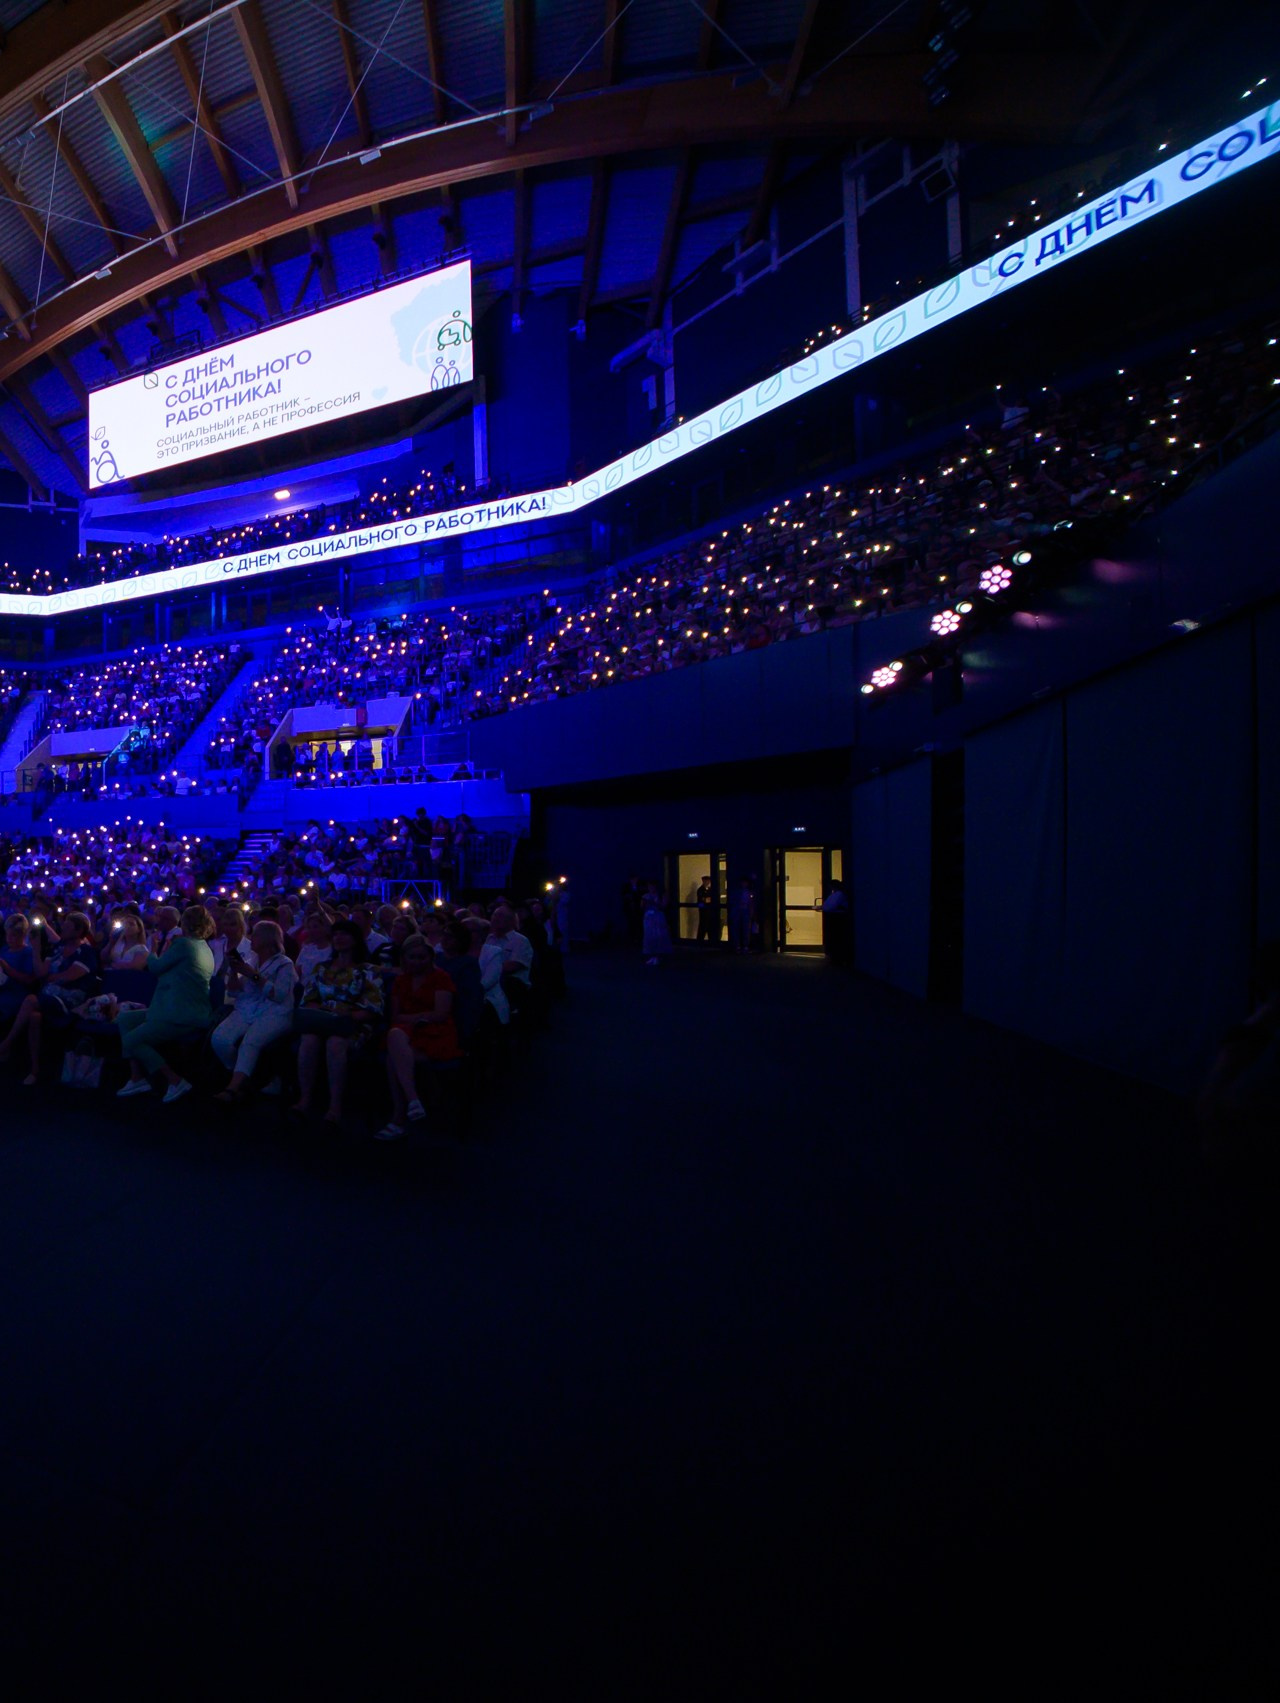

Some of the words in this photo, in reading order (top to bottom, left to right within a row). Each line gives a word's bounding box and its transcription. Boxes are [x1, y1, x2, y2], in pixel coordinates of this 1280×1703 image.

[998, 252, 1024, 278] С
[165, 374, 178, 389] С
[182, 353, 235, 387] ДНЁМ
[165, 349, 312, 408] СОЦИАЛЬНОГО
[156, 415, 235, 448] СОЦИАЛЬНЫЙ
[237, 397, 300, 425] РАБОТНИК
[156, 445, 179, 459] ЭТО
[181, 427, 249, 453] ПРИЗВАНИЕ,
[252, 422, 261, 431] А
[263, 415, 278, 429] НЕ
[281, 391, 361, 424] ПРОФЕССИЯ
[165, 378, 282, 429] РАБОТНИКА!
[223, 561, 234, 574] С
[287, 524, 417, 560] СОЦИАЛЬНОГО
[424, 497, 546, 534] РАБОТНИКА!
